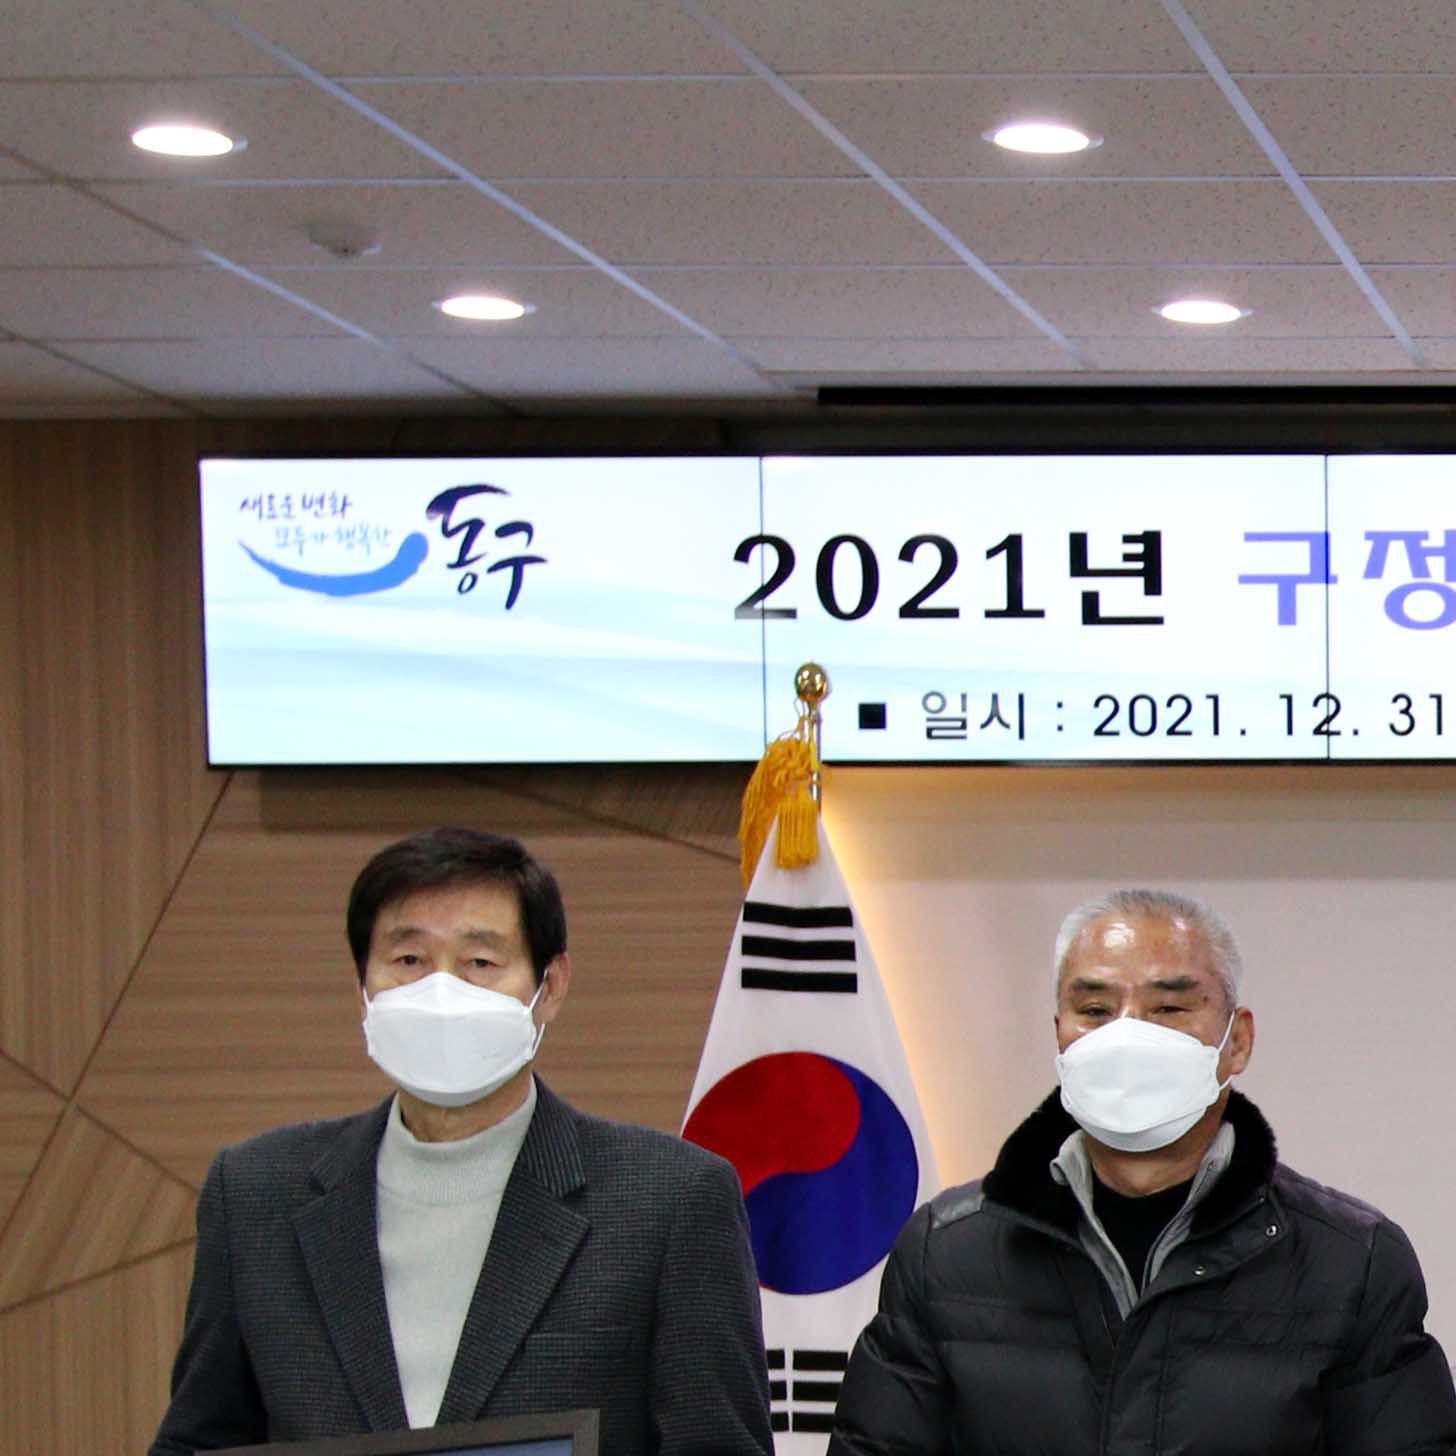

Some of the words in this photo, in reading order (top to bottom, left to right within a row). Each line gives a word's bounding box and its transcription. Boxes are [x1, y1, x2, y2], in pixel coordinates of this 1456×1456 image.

[302, 490, 352, 519] 변화
[333, 522, 392, 556] 행복한
[425, 483, 548, 610] 동구
[733, 528, 1167, 627] 2021년
[922, 692, 1027, 741] 일시
